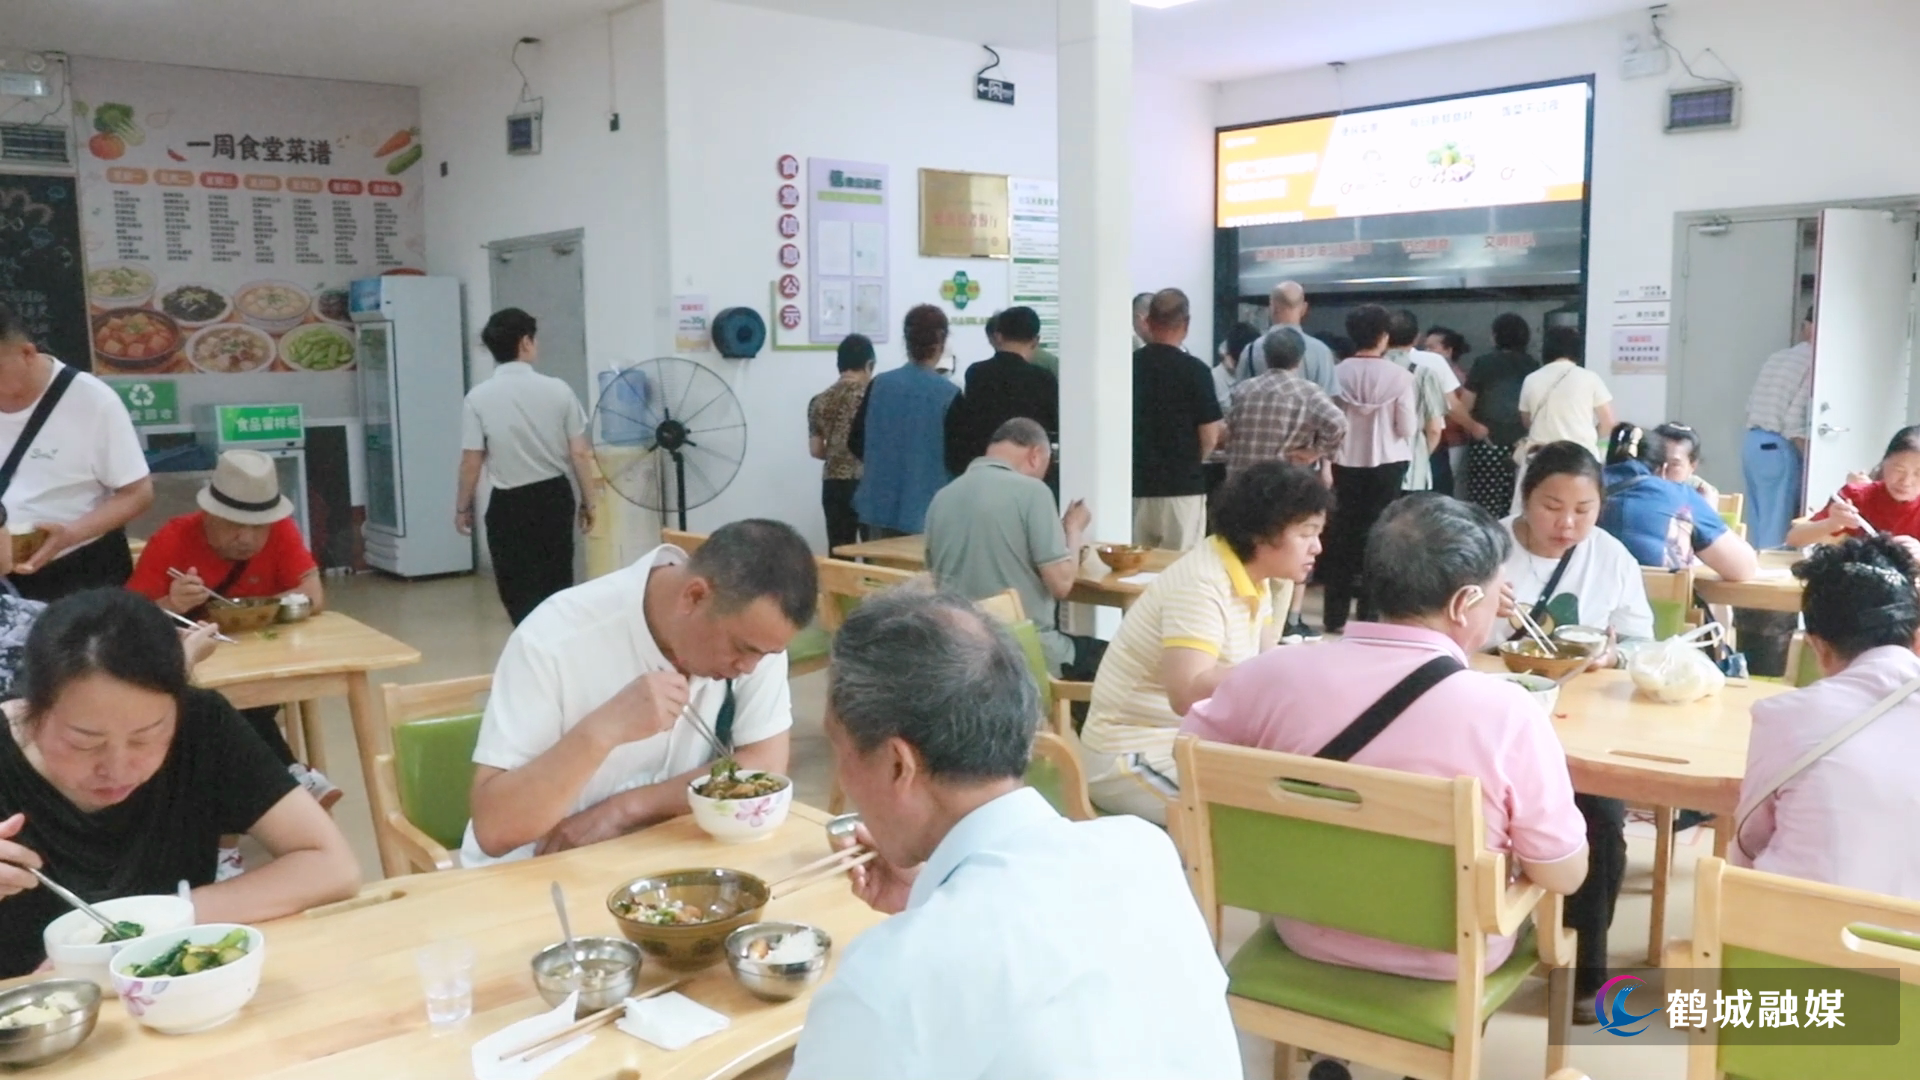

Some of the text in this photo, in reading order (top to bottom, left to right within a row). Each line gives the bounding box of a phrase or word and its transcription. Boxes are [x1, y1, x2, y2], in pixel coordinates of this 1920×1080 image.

[187, 134, 332, 165] 一周食堂菜谱
[236, 416, 300, 433] 食品留样柜
